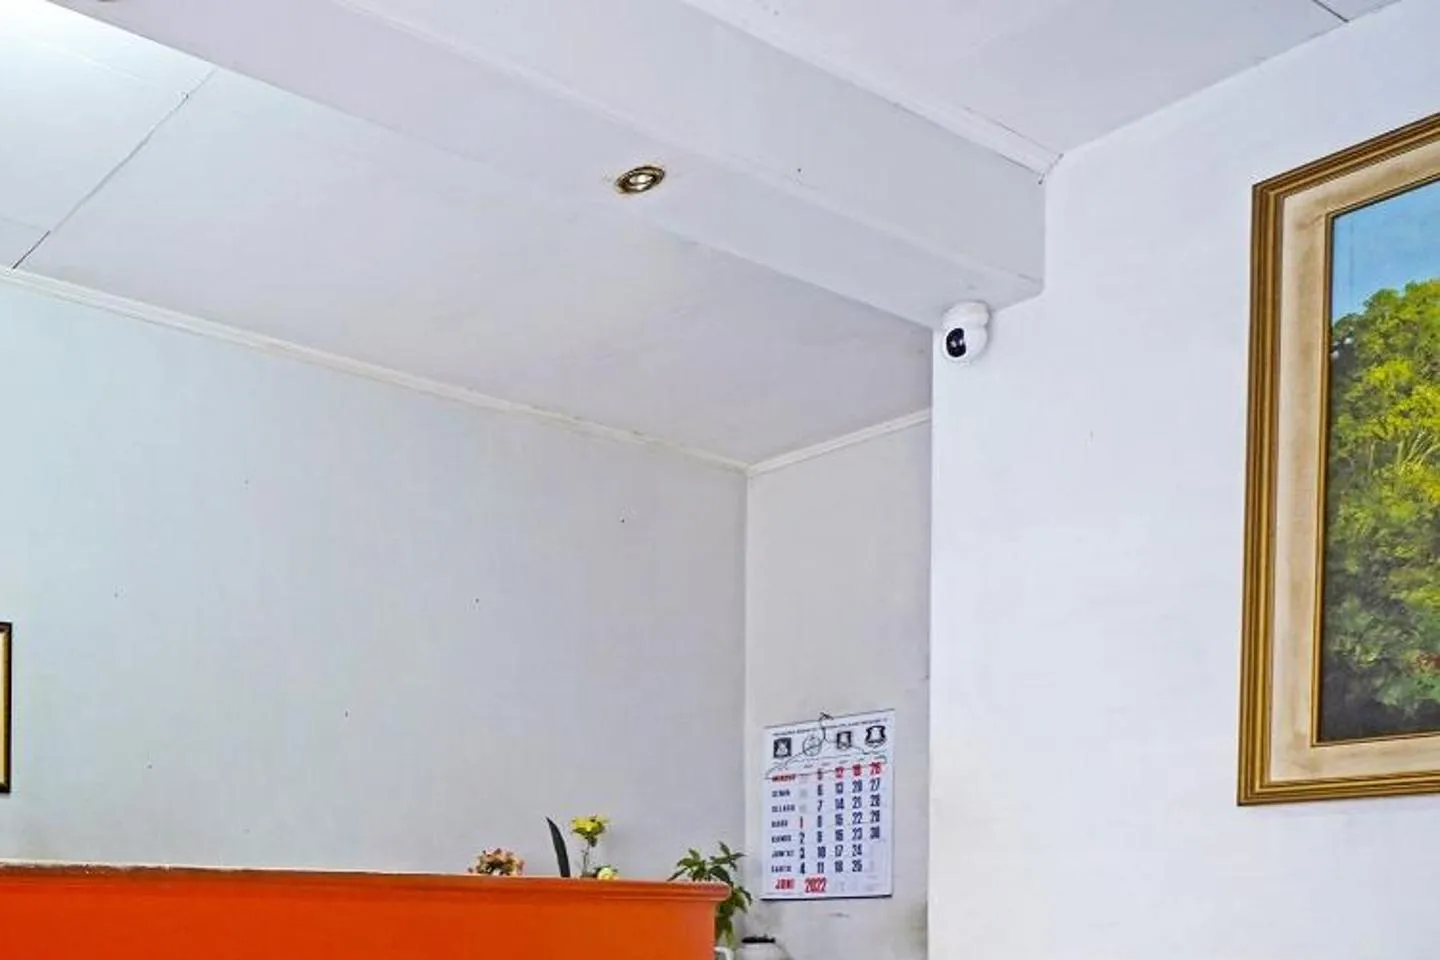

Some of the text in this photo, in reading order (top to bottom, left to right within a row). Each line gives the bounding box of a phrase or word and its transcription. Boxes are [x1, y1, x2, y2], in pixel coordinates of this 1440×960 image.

[852, 780, 863, 793] 20
[869, 777, 880, 791] 27
[817, 800, 823, 812] 7
[835, 798, 844, 809] 14
[852, 796, 862, 809] 21
[852, 812, 862, 825] 22
[799, 832, 805, 844] 2
[852, 827, 863, 840] 23
[799, 847, 805, 859] 3
[817, 846, 826, 858] 10
[835, 845, 843, 857] 17
[852, 844, 862, 857] 24
[800, 862, 805, 874] 4
[817, 862, 824, 873] 11
[852, 859, 863, 872] 25
[805, 877, 827, 893] 2022
